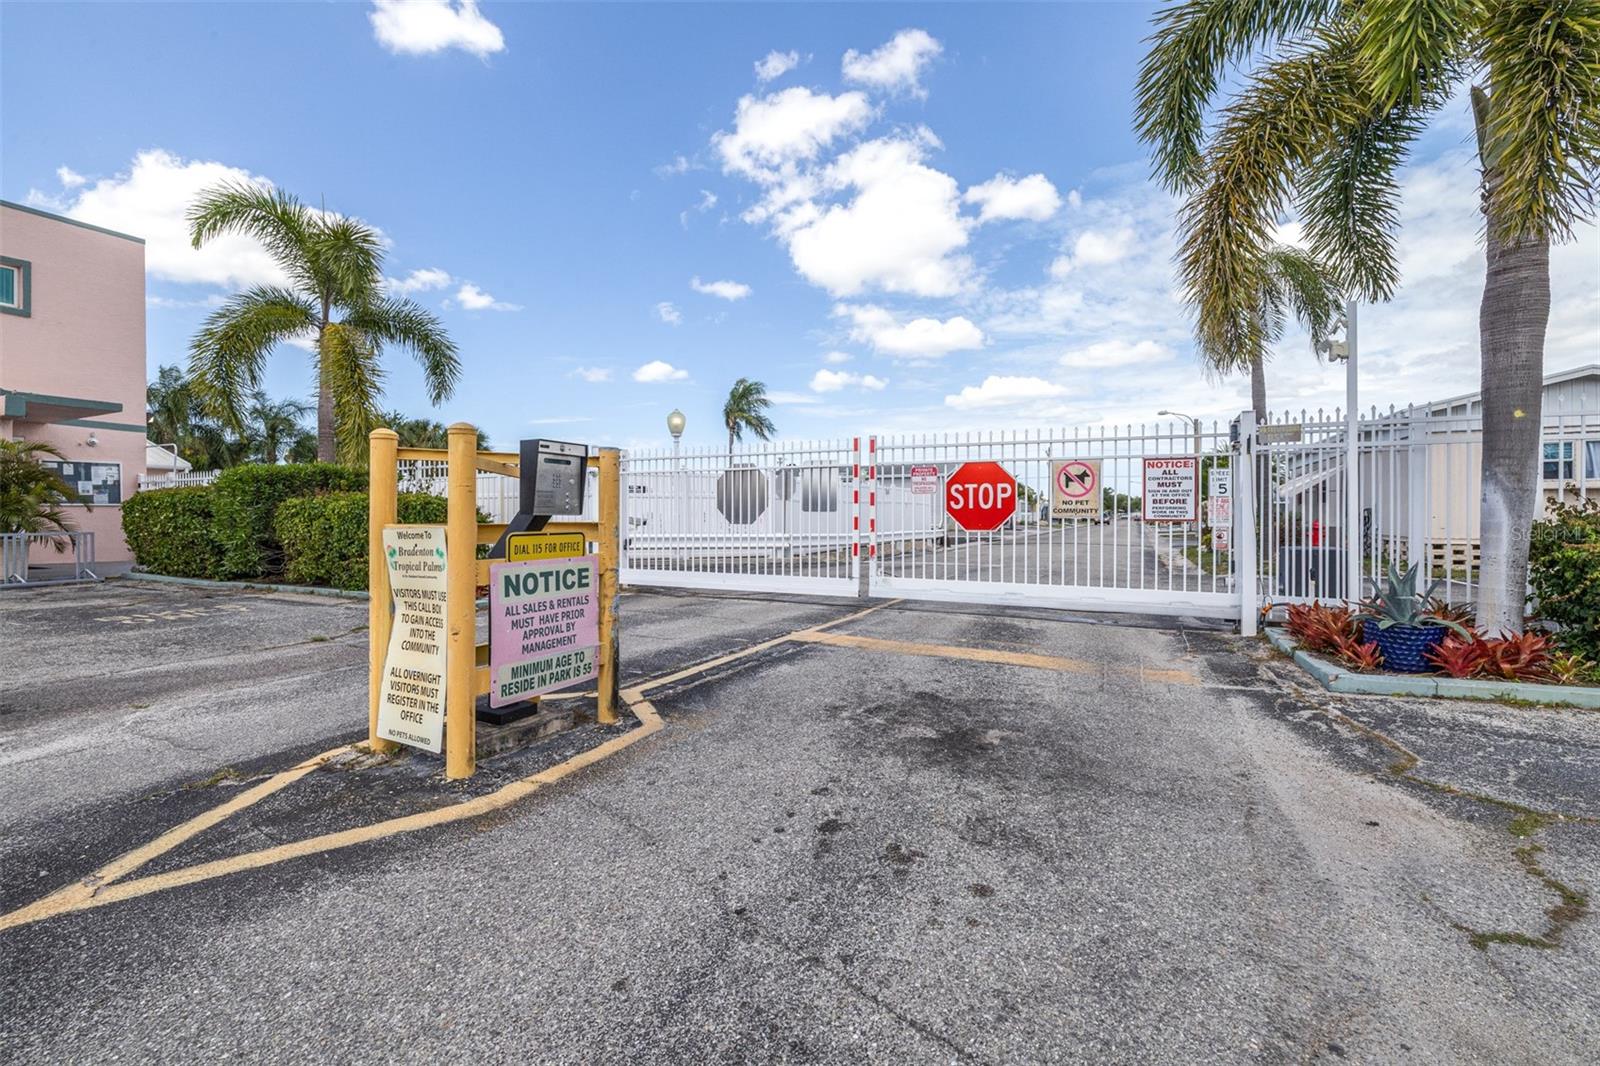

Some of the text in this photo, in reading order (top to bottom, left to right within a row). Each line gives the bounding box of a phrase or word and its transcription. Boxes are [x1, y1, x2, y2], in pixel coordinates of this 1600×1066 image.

[950, 483, 1012, 510] STOP
[397, 531, 432, 540] Welcome To
[399, 547, 434, 556] Bradenton
[514, 542, 580, 555] DIAL 115 FOR OFFICE
[394, 561, 443, 573] Tropical Palms
[504, 568, 590, 598] NOTICE
[393, 589, 446, 602] VISITORS MUST USE
[404, 601, 442, 614] THIS CALL BOX
[505, 595, 590, 617] ALL SALES & RENTALS
[402, 614, 443, 629] TO GAIN ACCESS
[511, 609, 585, 630] MUST HAVE PRIOR
[410, 628, 435, 640] INTO THE
[522, 622, 576, 641] APPROVAL BY
[401, 640, 440, 655] COMMUNITY
[522, 634, 577, 655] MANAGEMENT
[511, 651, 585, 680] MINIMUM AGE TO
[390, 667, 441, 685] ALL OVERNIGHT
[501, 663, 592, 697] RESIDE IN PARK IS 55
[390, 681, 439, 699] VISITORS MUST
[387, 693, 439, 714] REGISTER IN THE
[400, 710, 423, 724] OFFICE
[397, 731, 408, 739] PETS
[408, 733, 431, 745] ALLOWED
